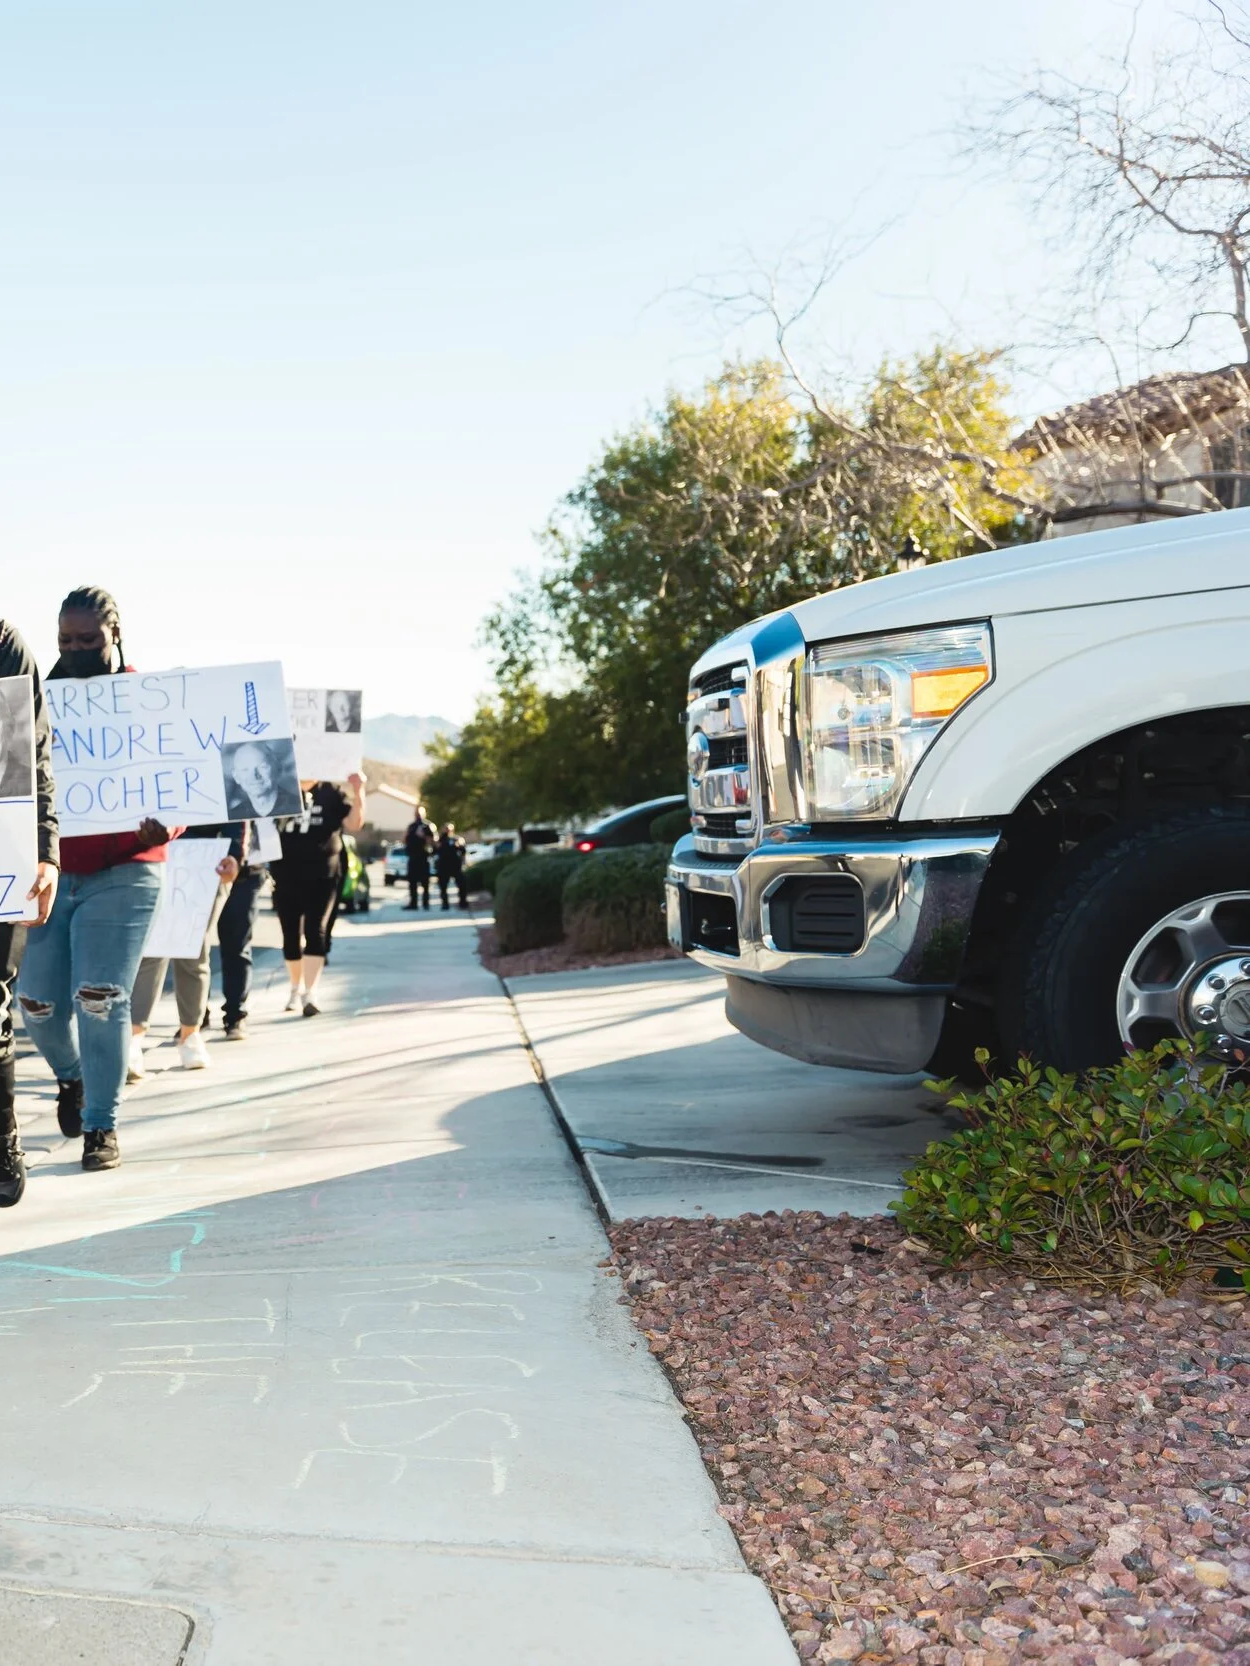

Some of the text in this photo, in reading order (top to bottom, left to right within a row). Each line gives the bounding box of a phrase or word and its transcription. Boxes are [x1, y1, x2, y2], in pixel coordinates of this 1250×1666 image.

[45, 672, 200, 720] ARREST
[52, 716, 227, 764] ANDREW
[54, 767, 219, 816] OCHER
